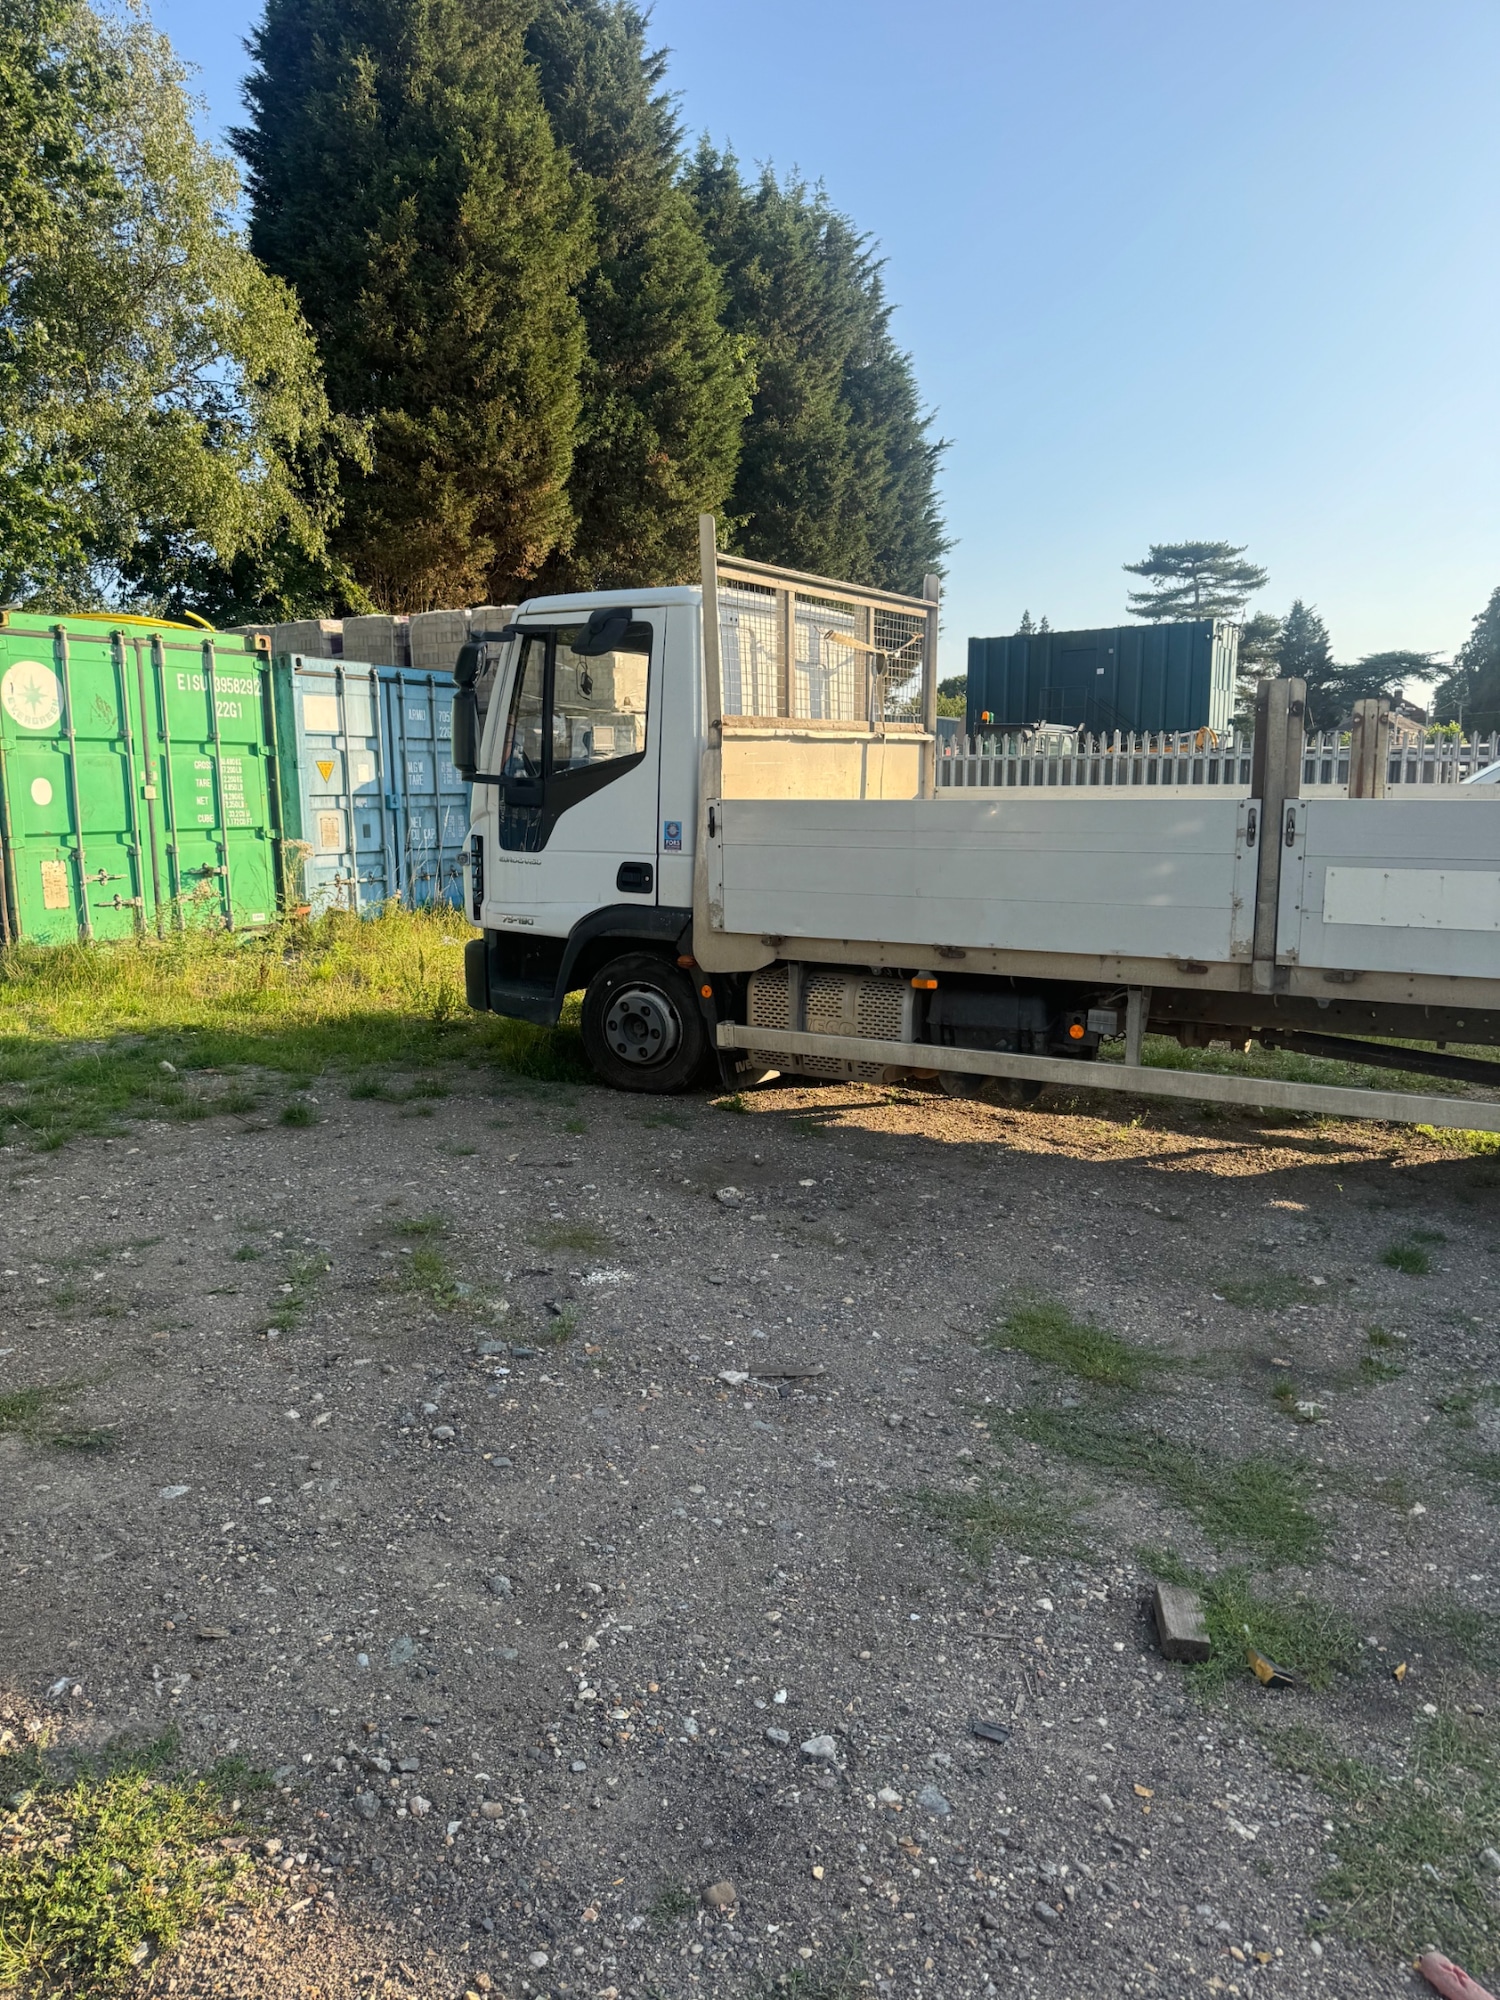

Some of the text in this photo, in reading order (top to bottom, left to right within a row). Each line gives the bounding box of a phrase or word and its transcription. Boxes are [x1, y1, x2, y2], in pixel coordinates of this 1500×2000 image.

[177, 673, 263, 696] EISU 3958292
[8, 697, 58, 725] EVERGREEN
[216, 701, 242, 719] 22G1
[194, 761, 213, 769] GROSS
[195, 779, 211, 788] TARE
[409, 774, 424, 785] TARE
[196, 796, 208, 805] NET
[197, 814, 214, 823] CUBE
[807, 1018, 856, 1035] VECO
[735, 1060, 752, 1073] IVE
